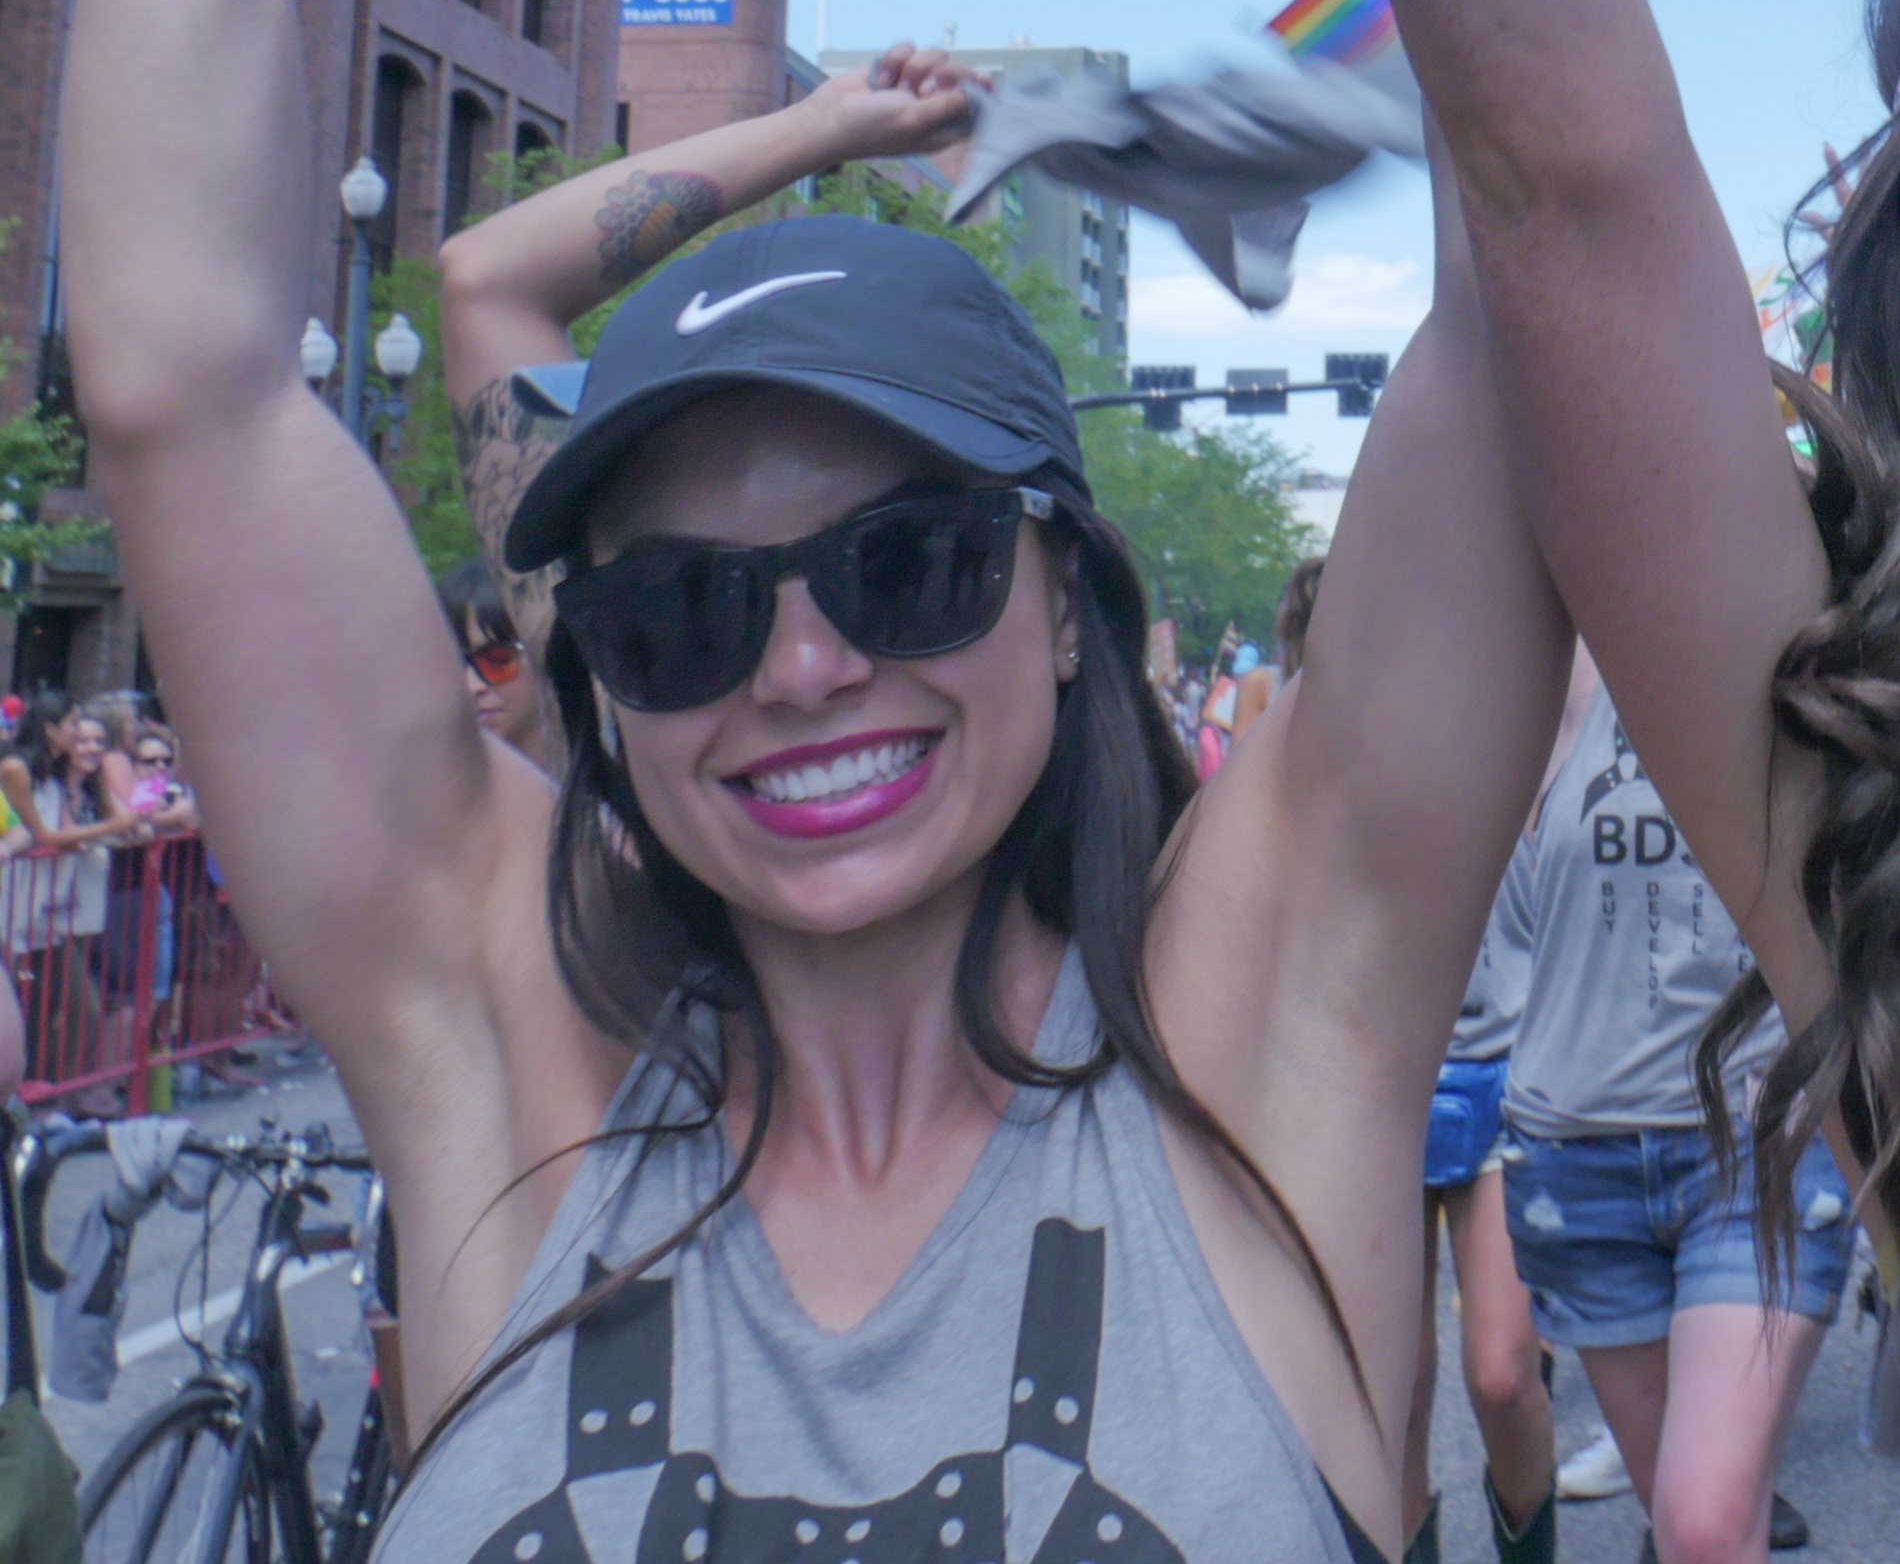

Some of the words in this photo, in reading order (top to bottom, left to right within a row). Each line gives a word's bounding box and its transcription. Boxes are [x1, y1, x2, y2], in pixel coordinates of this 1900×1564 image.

[1593, 813, 1695, 868] BD
[1601, 881, 1616, 935] BUY
[1692, 883, 1705, 956] SELL
